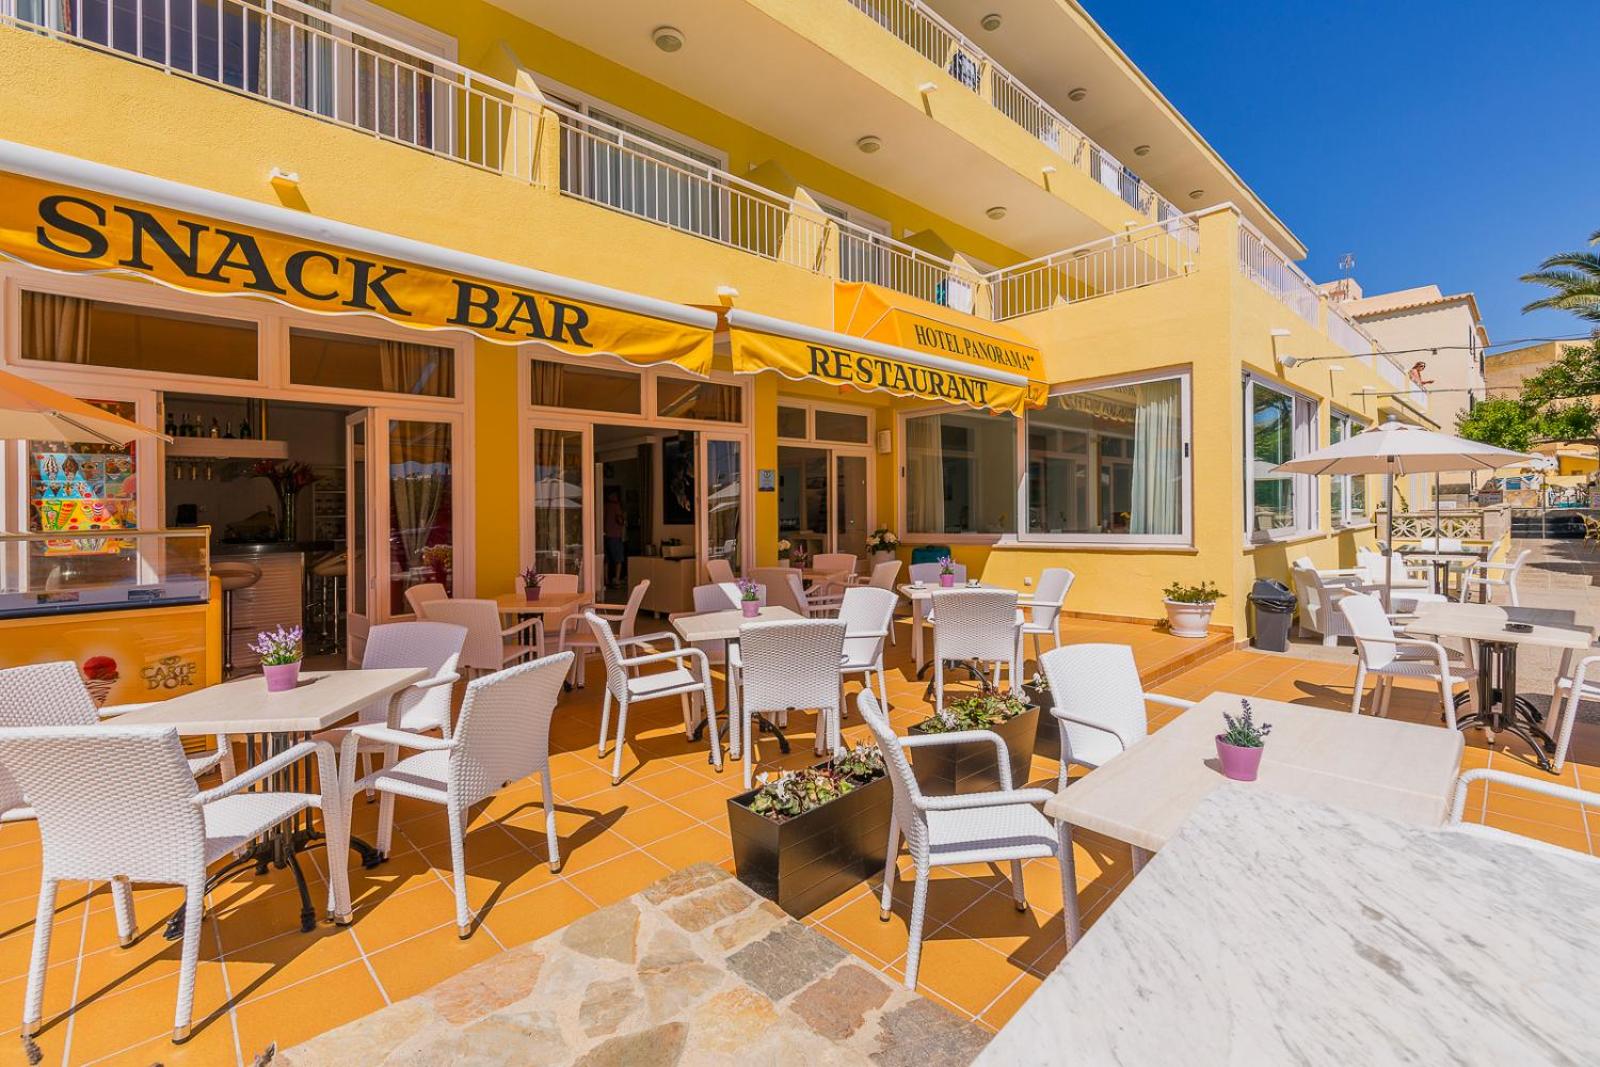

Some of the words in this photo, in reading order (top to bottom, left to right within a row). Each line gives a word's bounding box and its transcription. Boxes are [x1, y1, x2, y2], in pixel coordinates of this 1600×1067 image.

[36, 194, 412, 317] SNACK
[446, 279, 593, 347] BAR
[914, 324, 964, 355] HOTEL
[963, 337, 1031, 371] PANORAMA
[807, 345, 988, 404] RESTAURANT
[140, 661, 197, 681] CARTE
